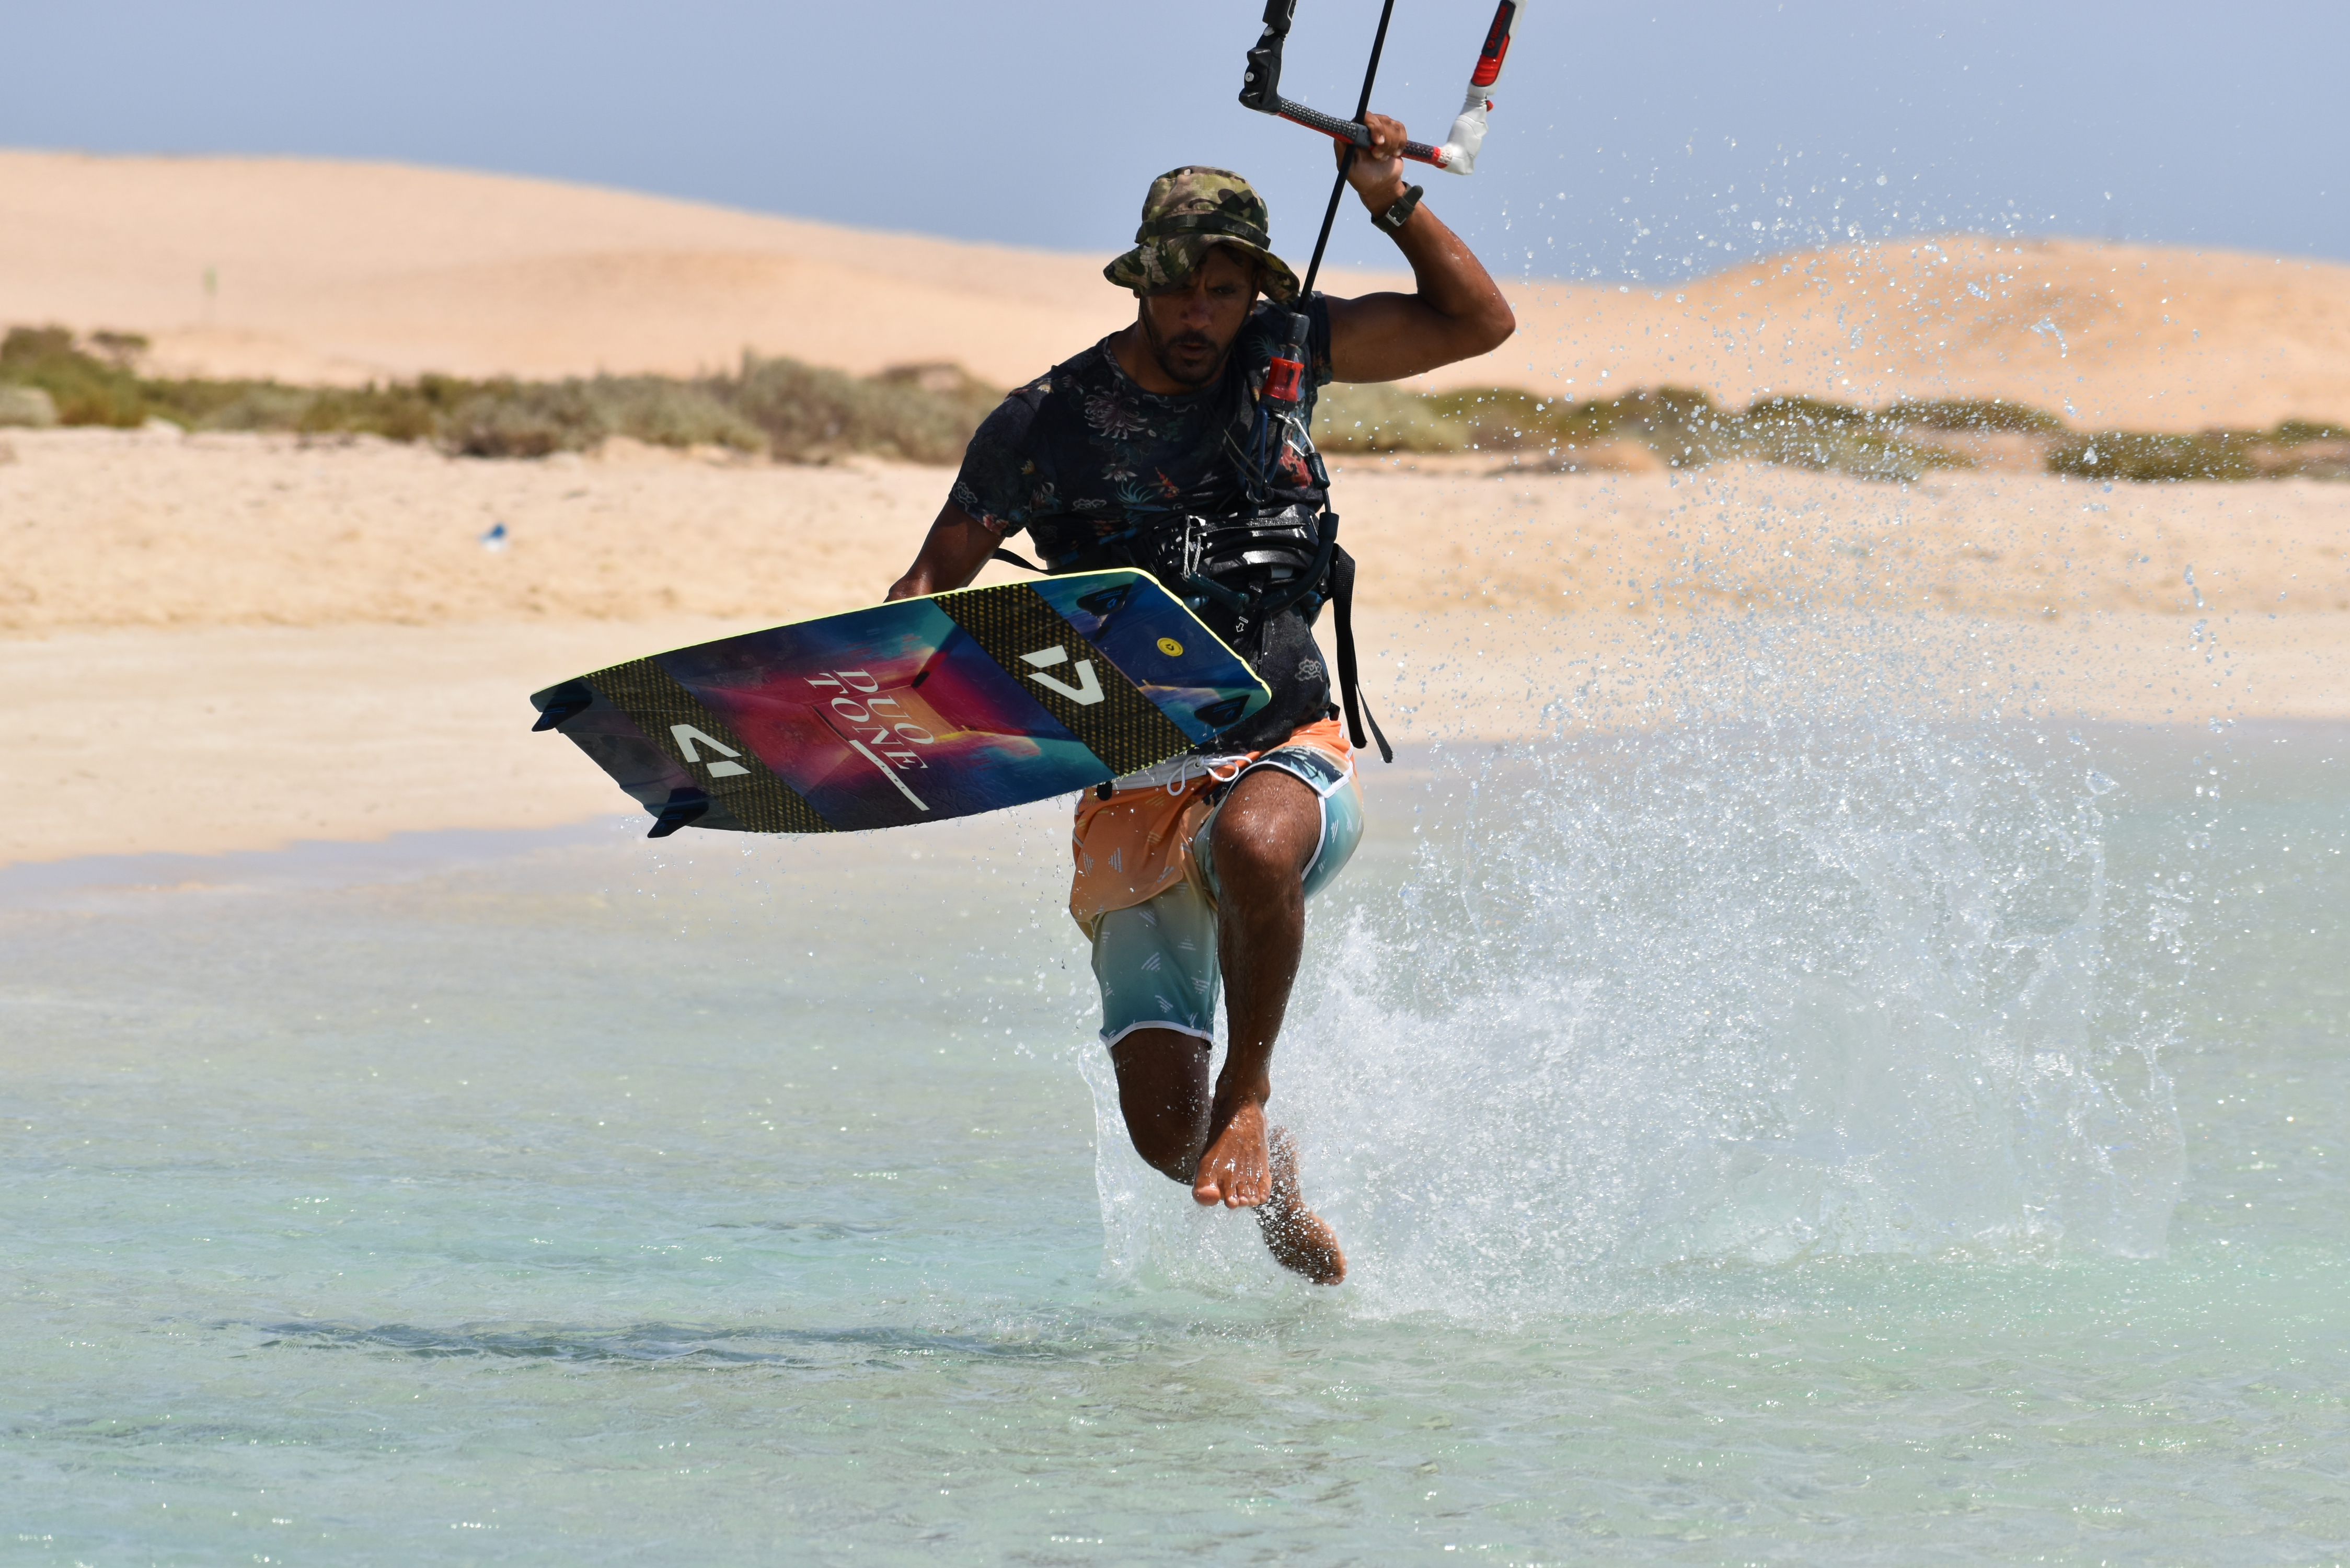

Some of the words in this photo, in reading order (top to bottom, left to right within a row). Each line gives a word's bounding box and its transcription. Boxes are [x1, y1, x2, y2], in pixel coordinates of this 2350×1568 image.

[803, 673, 928, 770] TONE
[833, 668, 934, 744] DUO
[874, 760, 905, 789] JAIME
